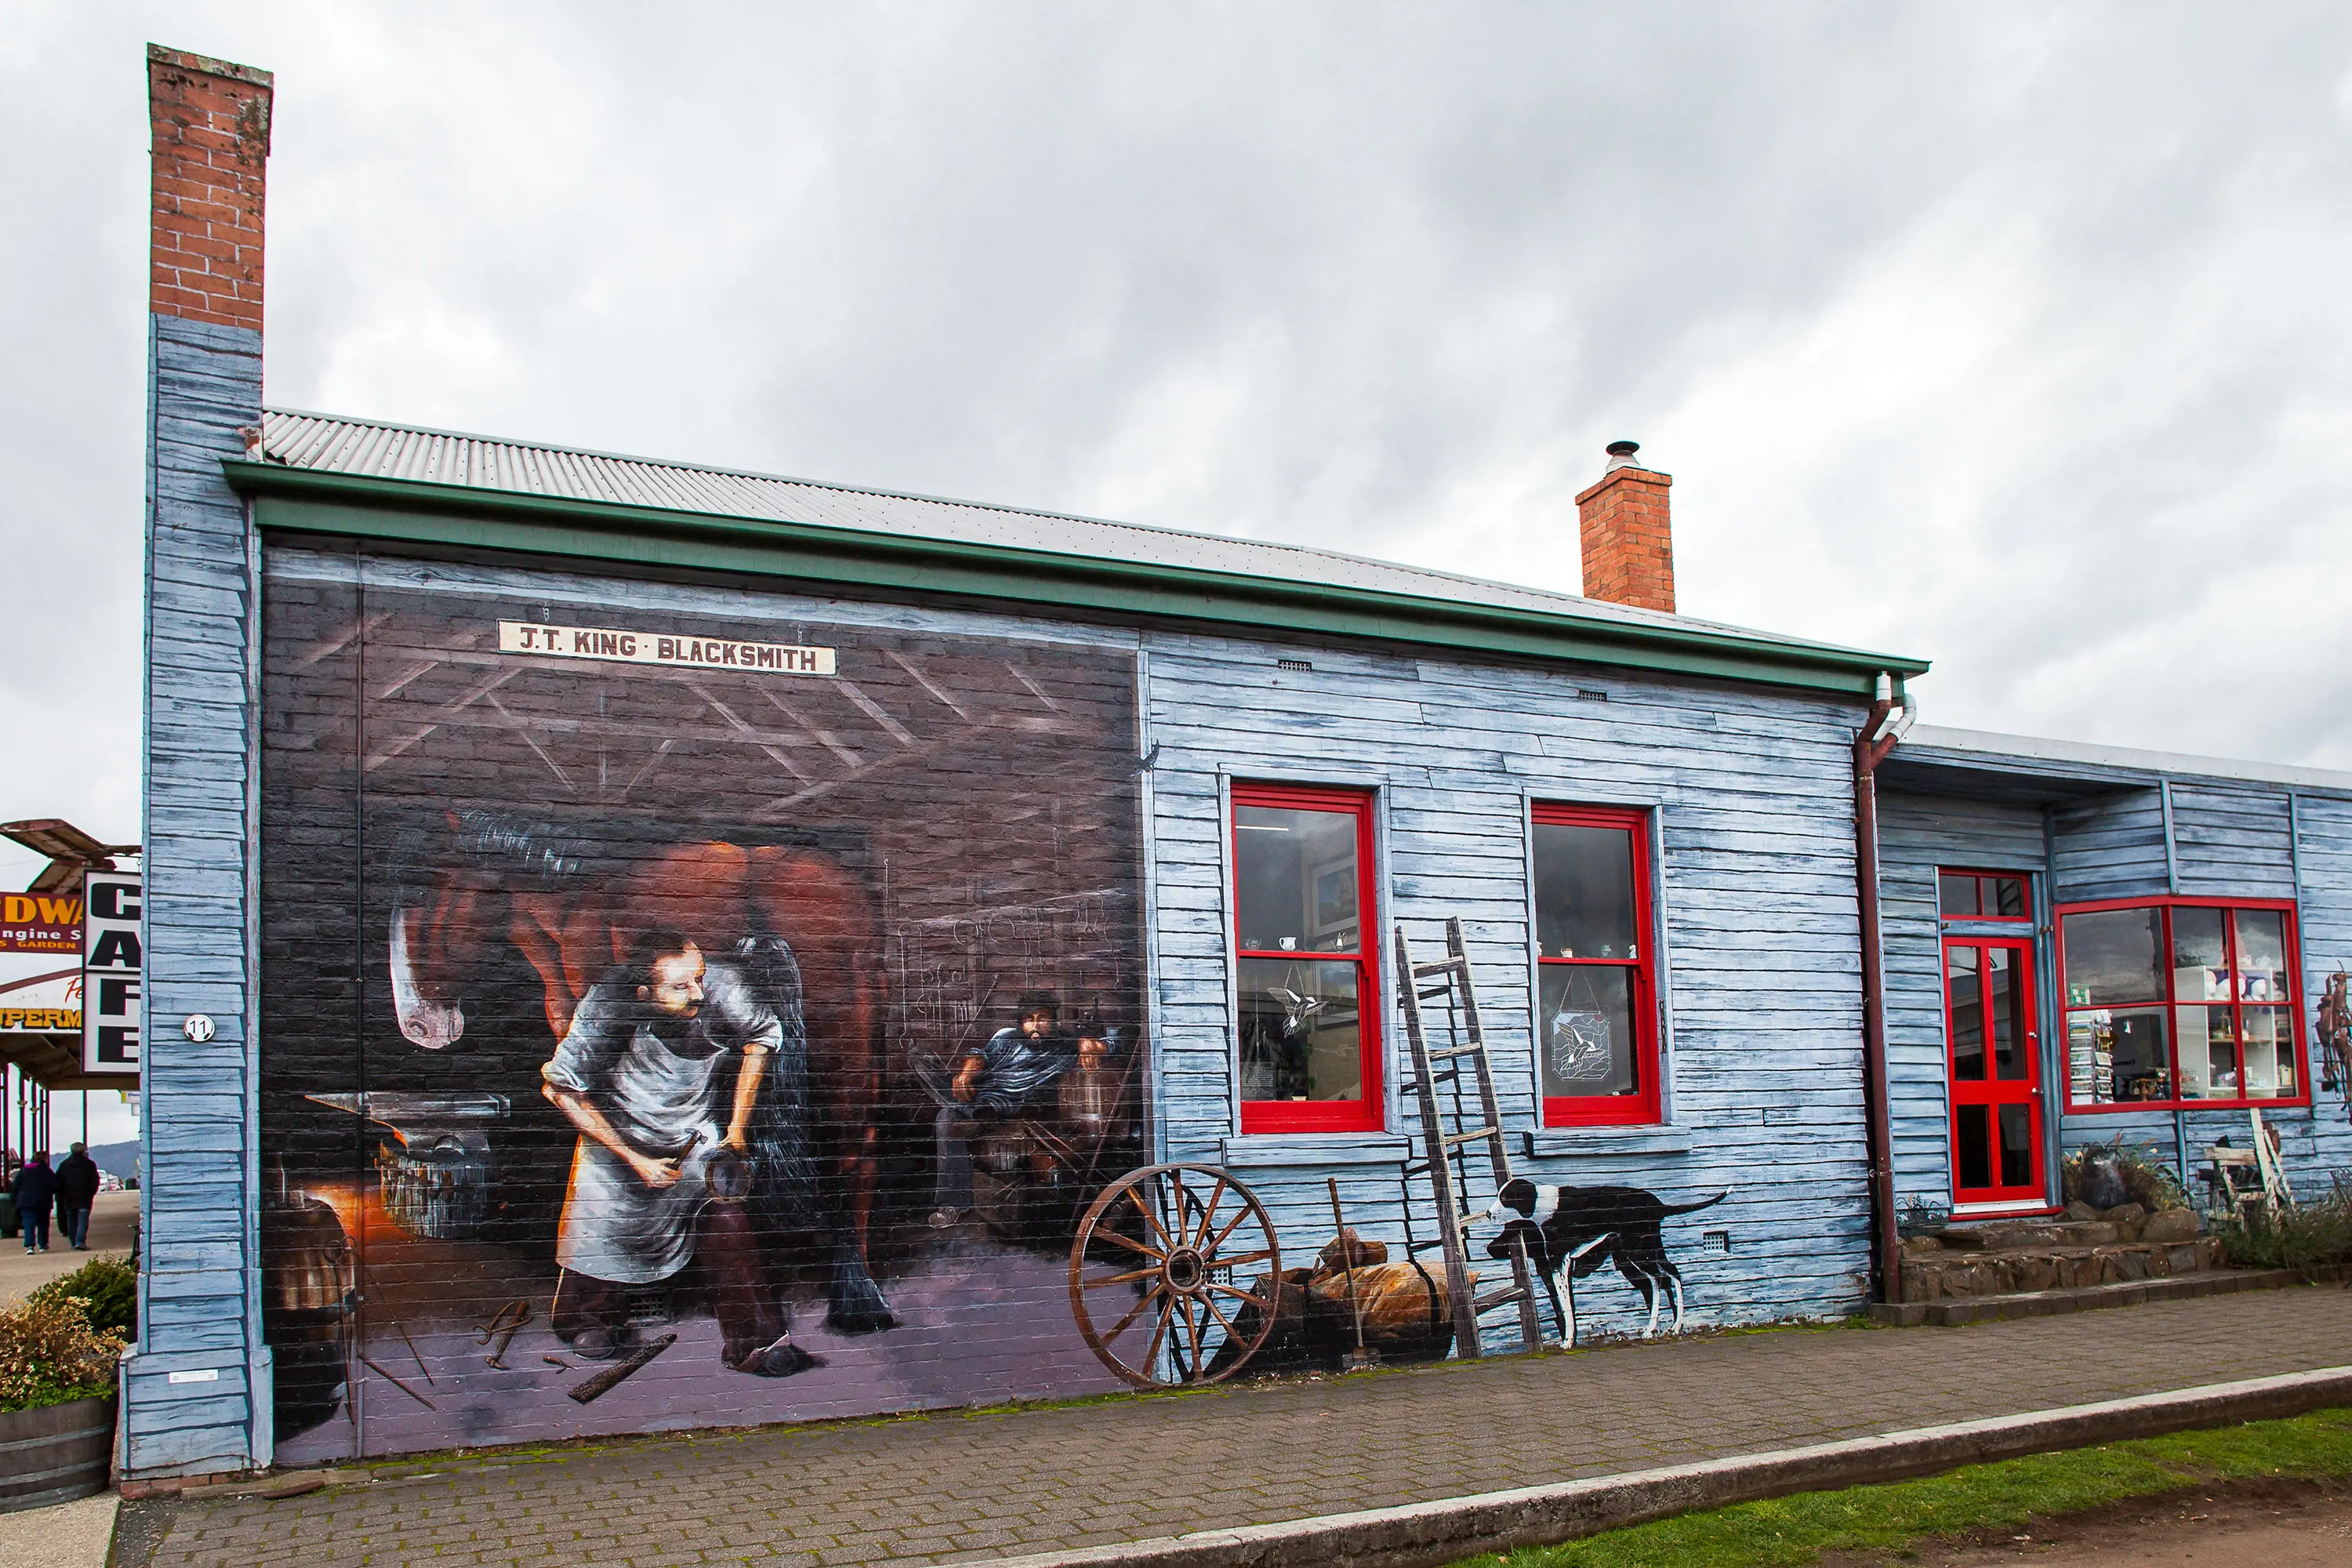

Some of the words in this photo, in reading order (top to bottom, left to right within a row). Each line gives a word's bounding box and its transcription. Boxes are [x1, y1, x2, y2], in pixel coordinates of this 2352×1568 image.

[520, 627, 563, 652] J.T.
[574, 631, 637, 656] KING
[657, 638, 816, 671] BLACKSMITH
[89, 883, 142, 1062] CAFE
[0, 1008, 82, 1029] PERM
[190, 1020, 205, 1034] 11
